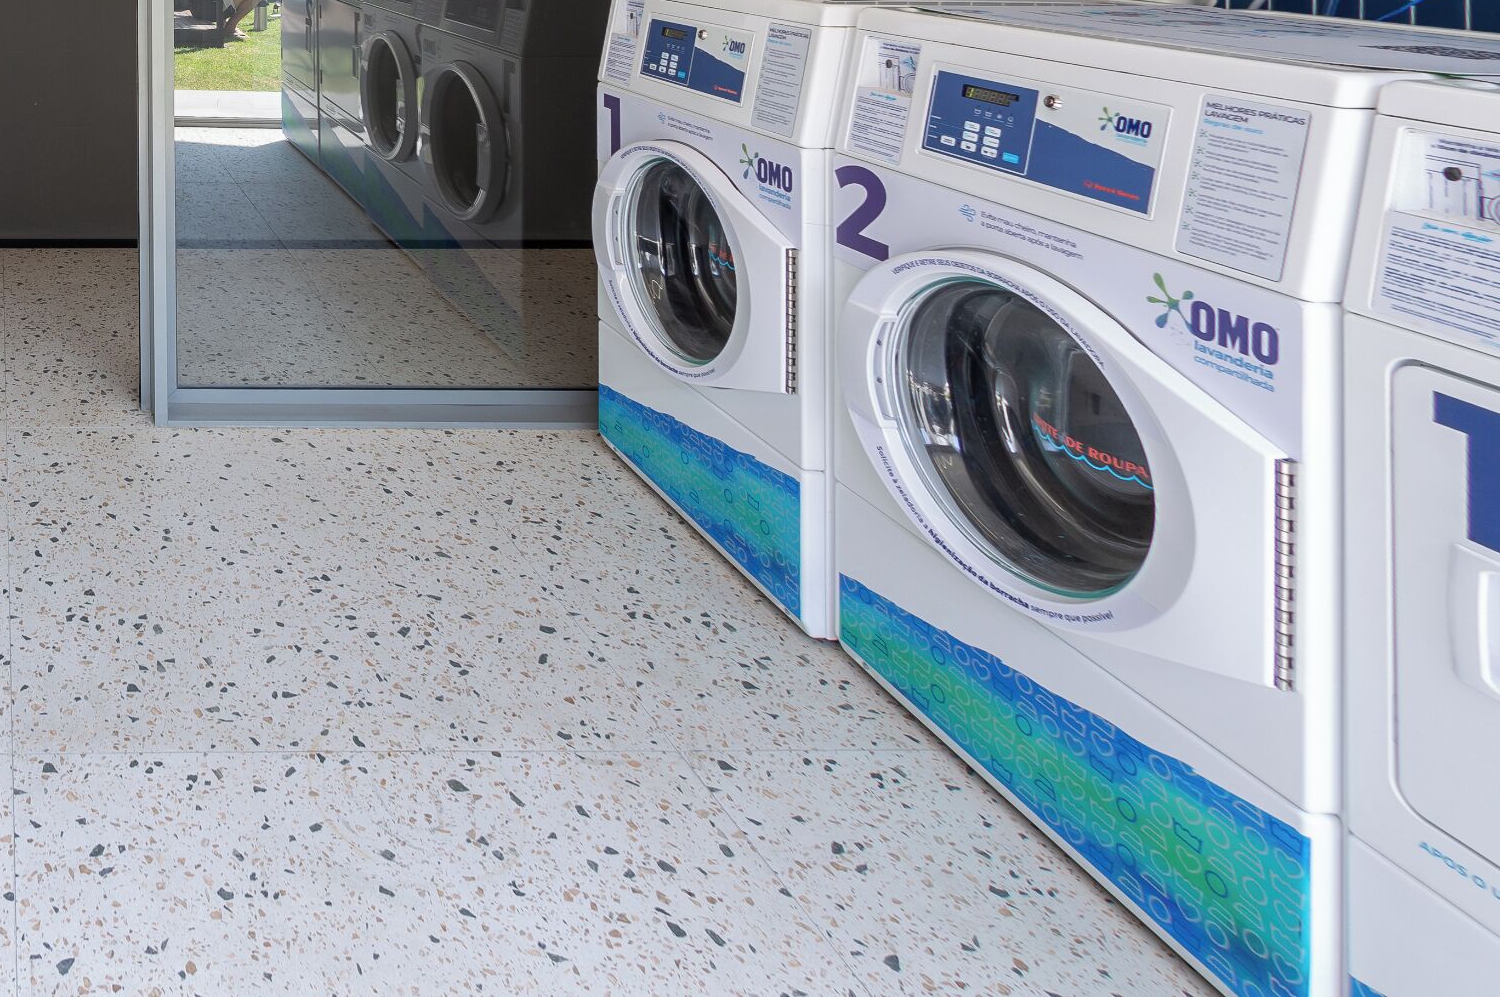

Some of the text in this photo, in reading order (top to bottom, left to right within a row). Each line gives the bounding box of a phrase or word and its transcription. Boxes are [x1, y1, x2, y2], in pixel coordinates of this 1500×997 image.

[729, 40, 746, 54] OMO
[604, 93, 621, 158] 1
[1115, 116, 1152, 139] OMO
[1204, 109, 1249, 124] LAVAGEM
[1206, 102, 1306, 126] MELHORES PRÁTICAS
[757, 157, 793, 193] OMO
[759, 184, 791, 202] lavanderia
[834, 165, 890, 262] 2
[1191, 300, 1279, 365] OMO
[1194, 340, 1274, 379] lavanderia
[1194, 356, 1275, 392] compartilhada
[1065, 435, 1084, 453] DE
[876, 445, 894, 477] Solicite
[896, 484, 923, 523] zeladoria
[928, 529, 977, 577] higienização
[978, 575, 989, 586] da
[989, 581, 1029, 609] borracha
[1030, 605, 1063, 620] sempre
[1064, 614, 1081, 622] que
